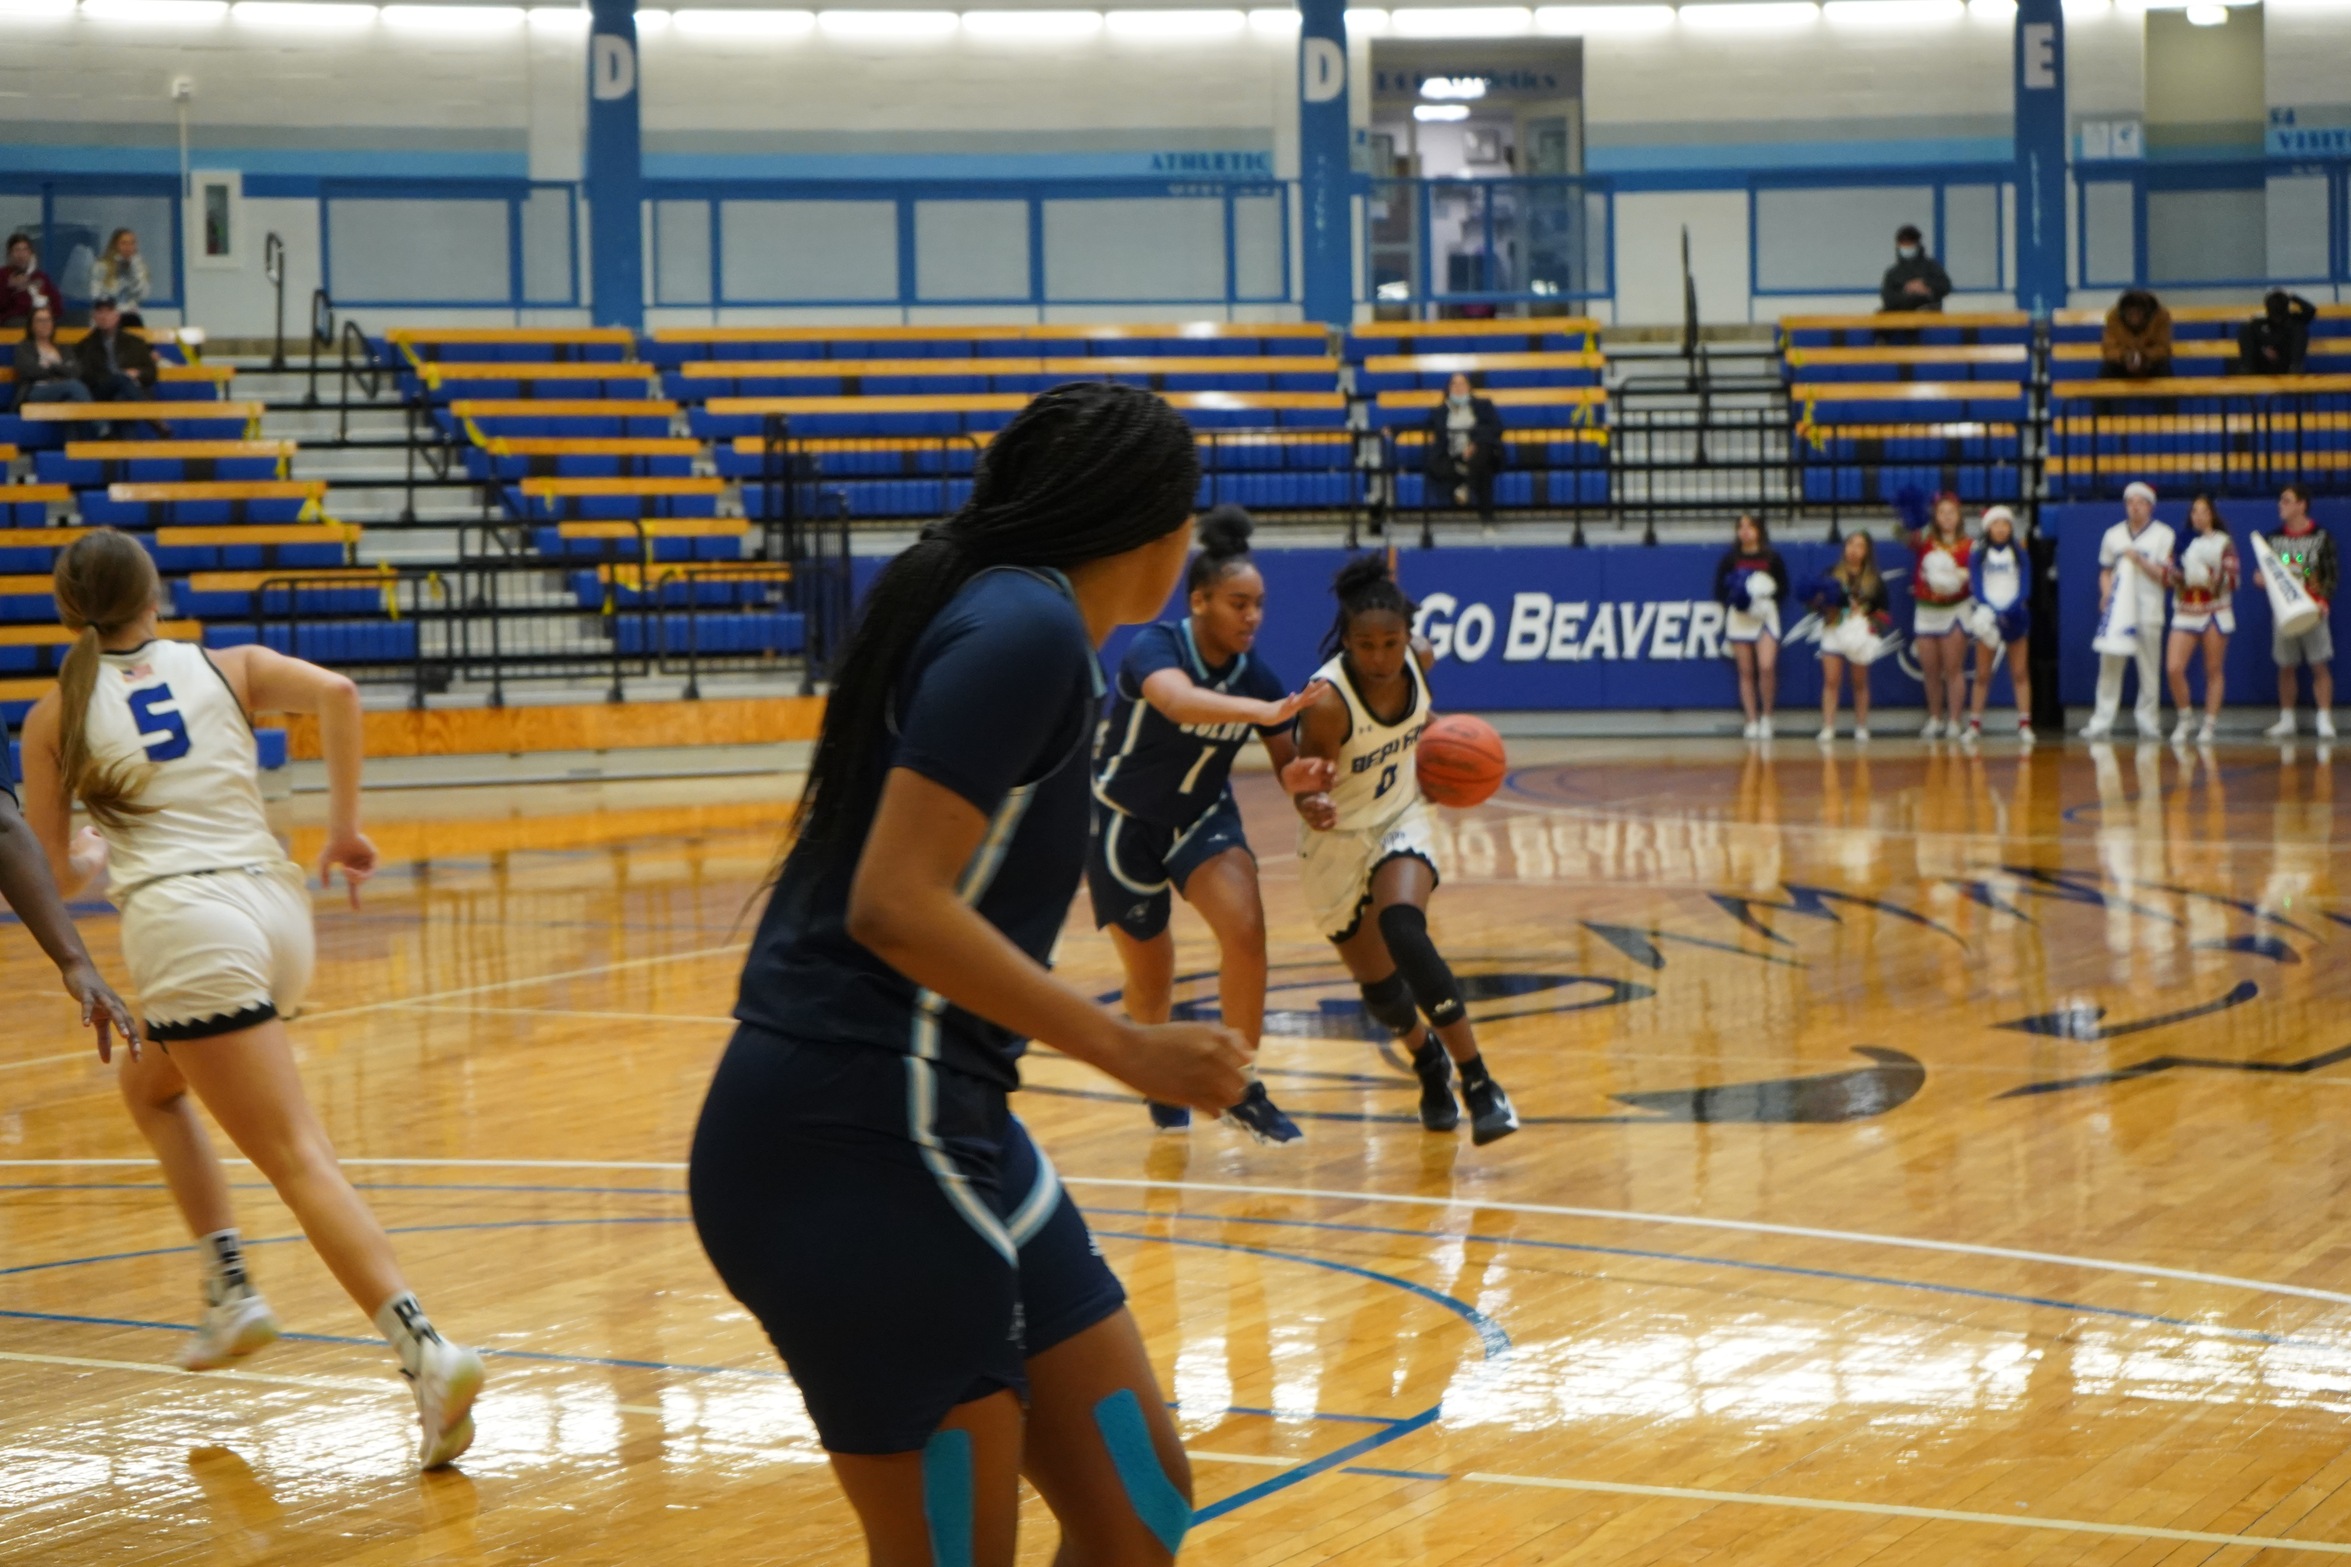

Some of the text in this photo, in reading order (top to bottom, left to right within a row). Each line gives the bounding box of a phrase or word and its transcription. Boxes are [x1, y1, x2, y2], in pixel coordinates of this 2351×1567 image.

[594, 34, 634, 100] D
[1303, 37, 1344, 102] D
[2023, 23, 2056, 88] E
[2276, 129, 2351, 149] VISIT
[1503, 592, 1736, 661] BEAVER
[127, 682, 192, 762] 5
[1178, 745, 1219, 795] 1
